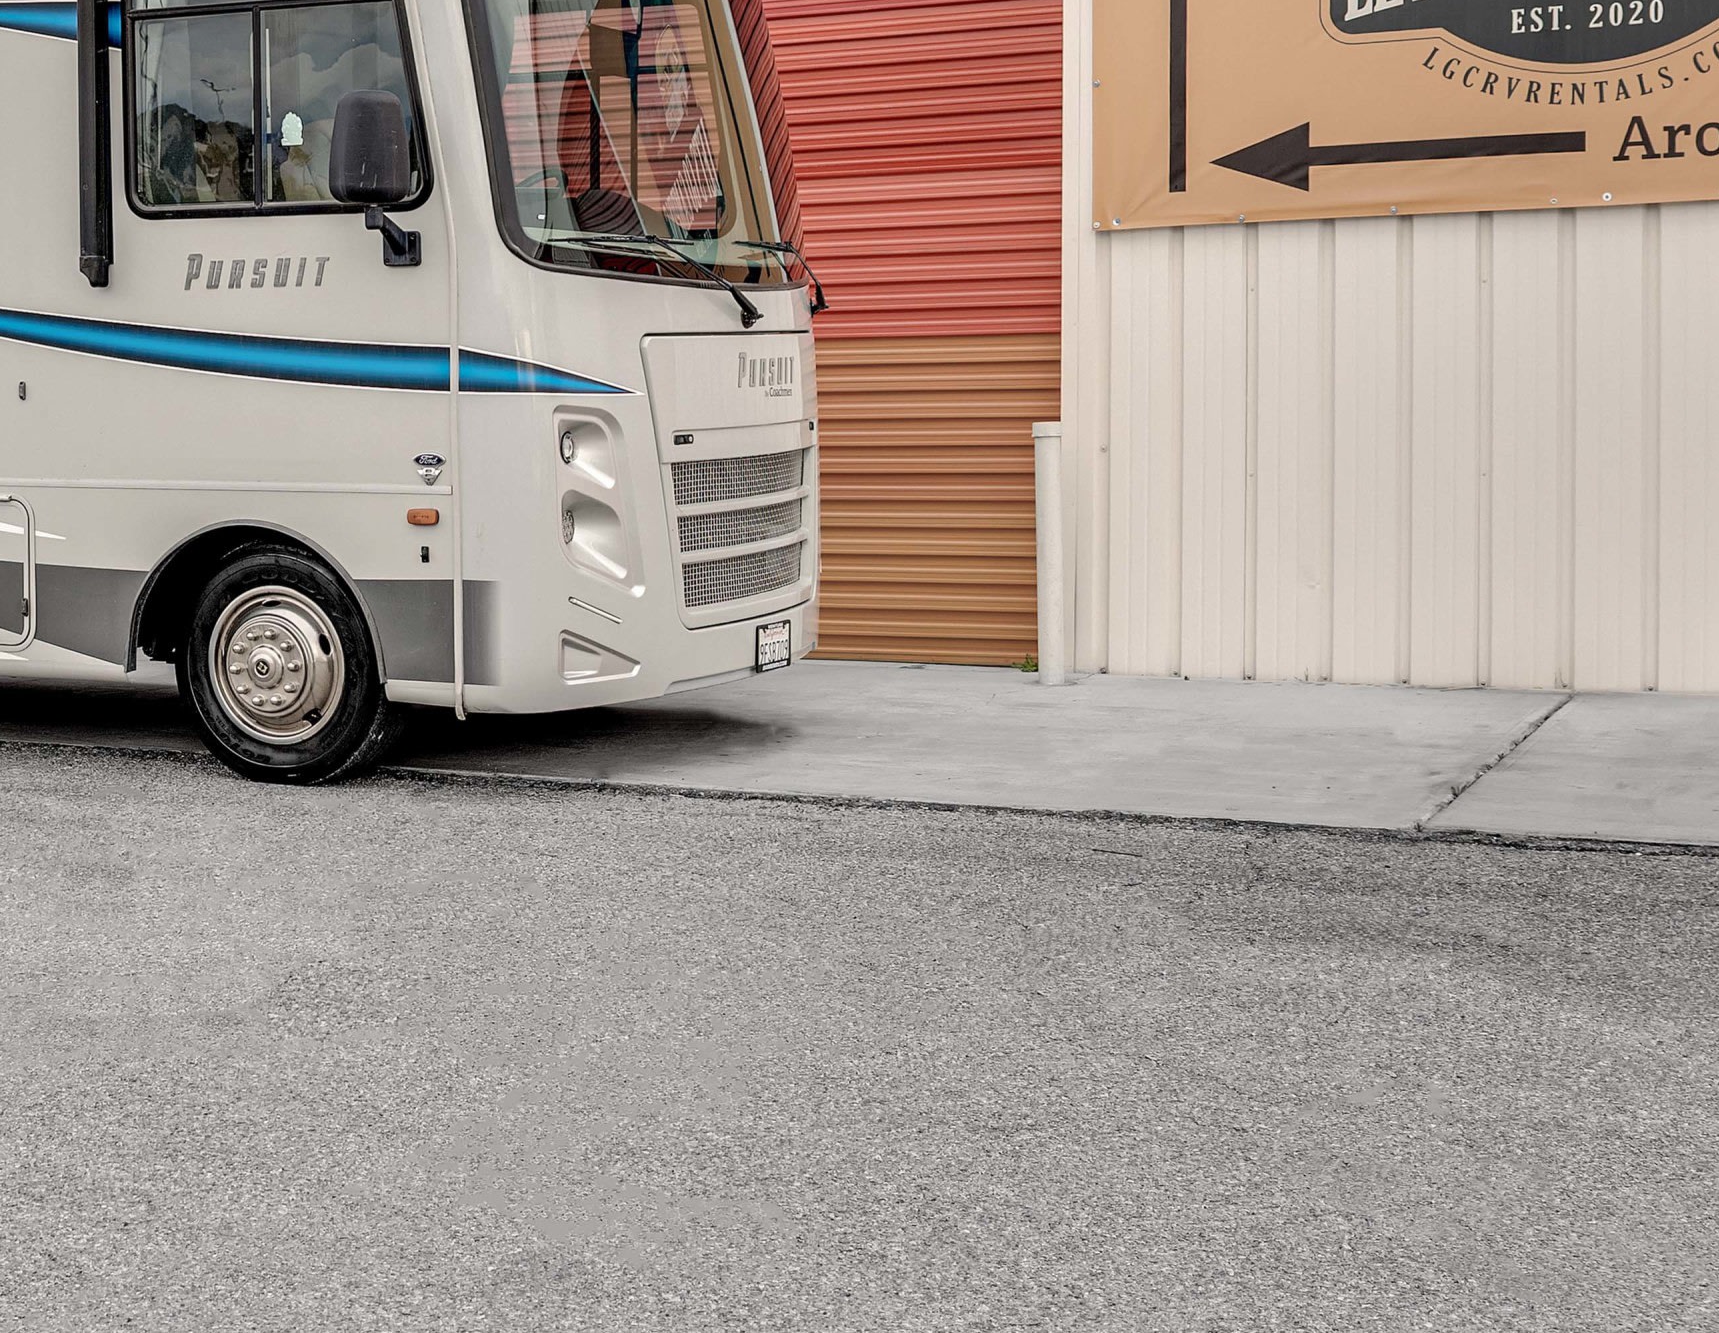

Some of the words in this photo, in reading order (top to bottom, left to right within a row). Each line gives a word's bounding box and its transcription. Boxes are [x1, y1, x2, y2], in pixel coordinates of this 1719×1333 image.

[1510, 4, 1573, 34] EST.
[183, 253, 331, 291] PURSUIT
[737, 352, 794, 388] PURSUIT
[418, 454, 439, 465] Ford
